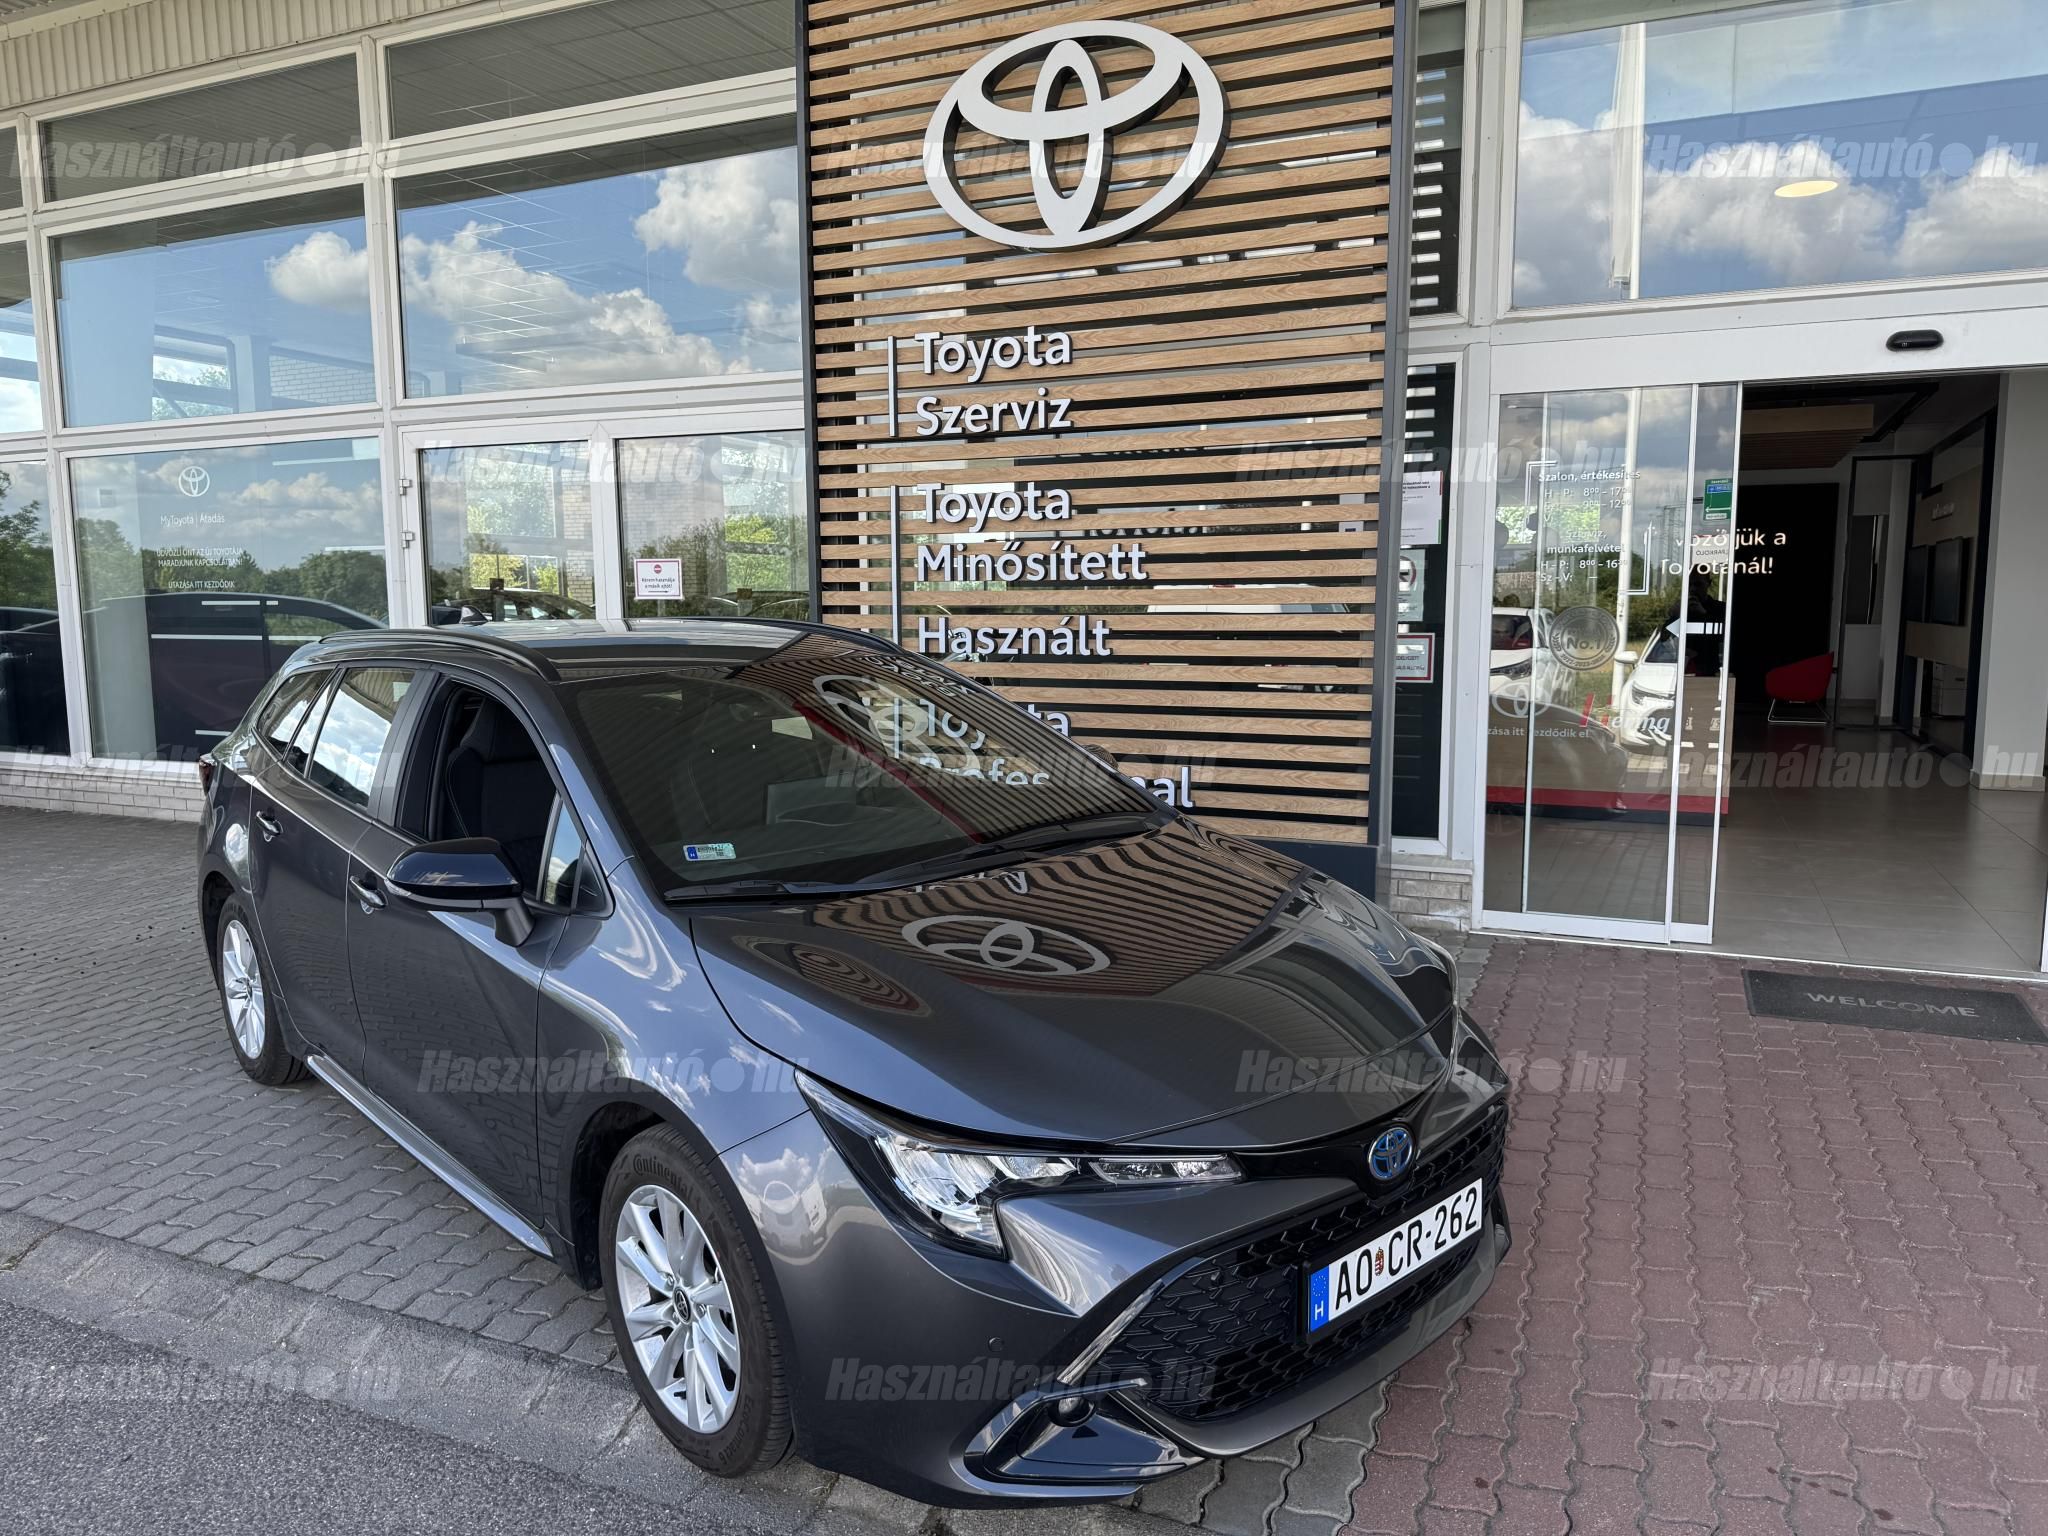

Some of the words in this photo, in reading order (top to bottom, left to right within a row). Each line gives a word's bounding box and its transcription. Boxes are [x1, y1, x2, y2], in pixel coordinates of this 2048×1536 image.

[914, 326, 1073, 383] Toyota
[916, 387, 1074, 435] Szerviz
[916, 482, 1074, 533] Toyota
[1773, 532, 1787, 546] a
[917, 541, 1150, 582] Minősített
[917, 615, 1113, 656] Használt
[1533, 727, 1577, 739] ezdődik
[1807, 992, 1980, 1018] WELCOME
[1335, 1248, 1373, 1311] AO
[1387, 1186, 1478, 1277] CR-262
[1314, 1300, 1324, 1321] H
